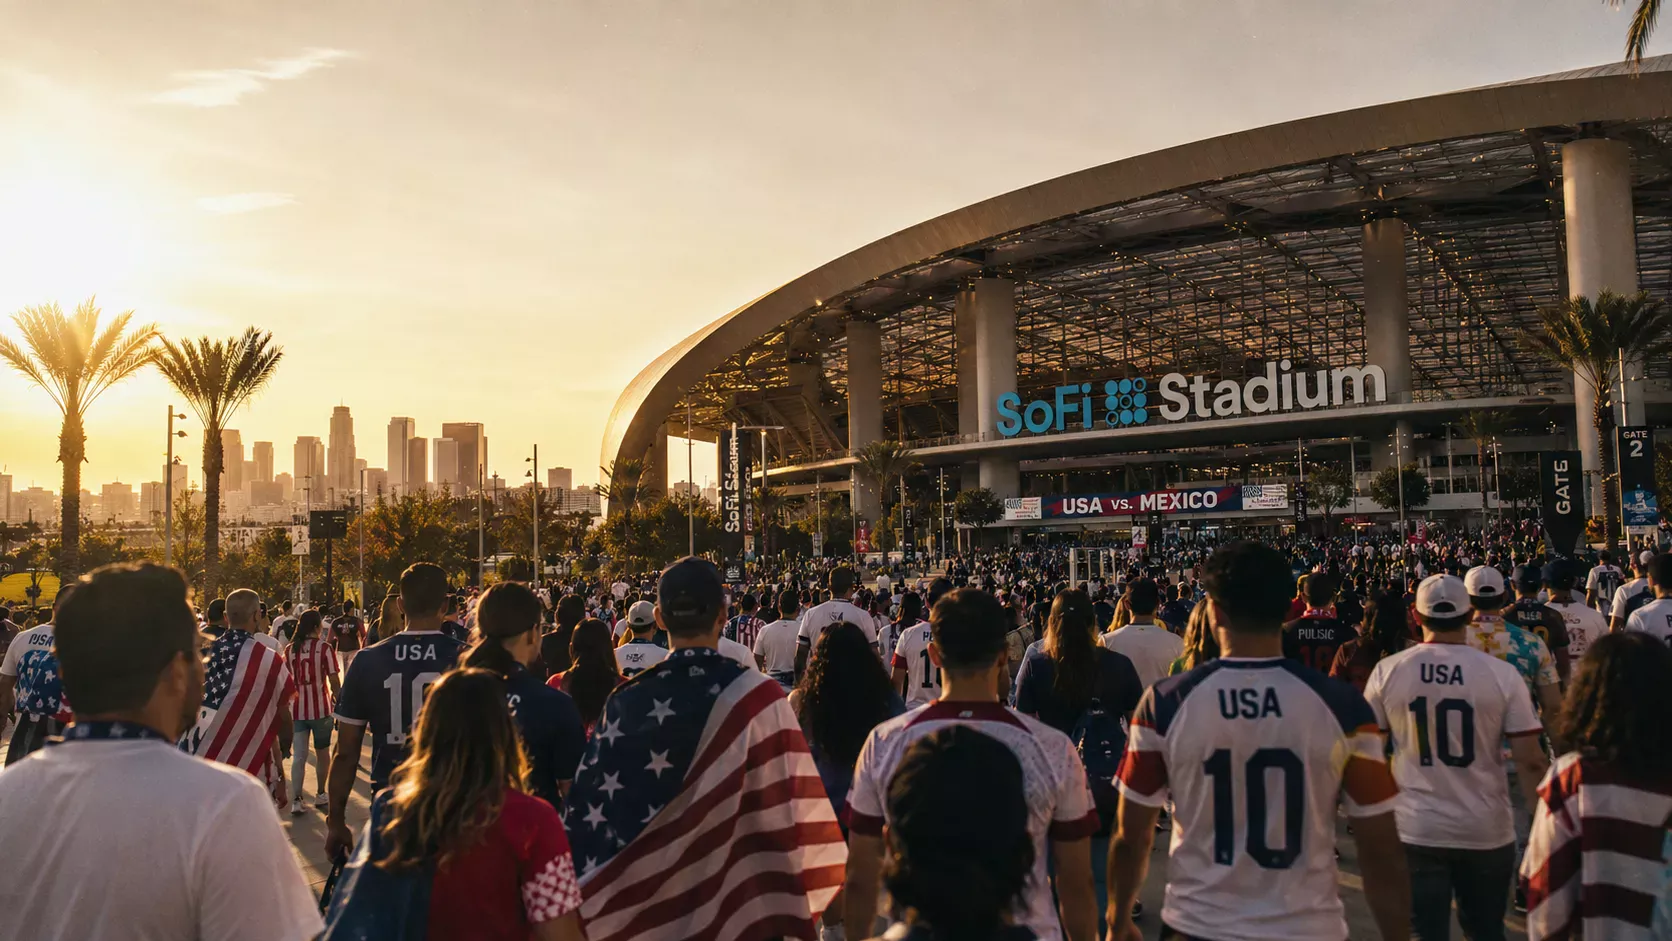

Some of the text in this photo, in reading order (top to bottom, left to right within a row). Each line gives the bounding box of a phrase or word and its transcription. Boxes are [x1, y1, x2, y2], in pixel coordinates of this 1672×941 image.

[996, 359, 1387, 437] SoFi Stadium
[1623, 430, 1648, 439] GATE
[1629, 440, 1643, 457] 2
[1062, 497, 1103, 514] USA
[1140, 491, 1217, 511] MEXICO
[1298, 628, 1334, 640] PULISIC
[395, 643, 437, 661] USA
[1420, 663, 1464, 685] USA
[1218, 687, 1283, 720] USA
[1409, 696, 1474, 768] 10
[1203, 748, 1305, 869] 10
